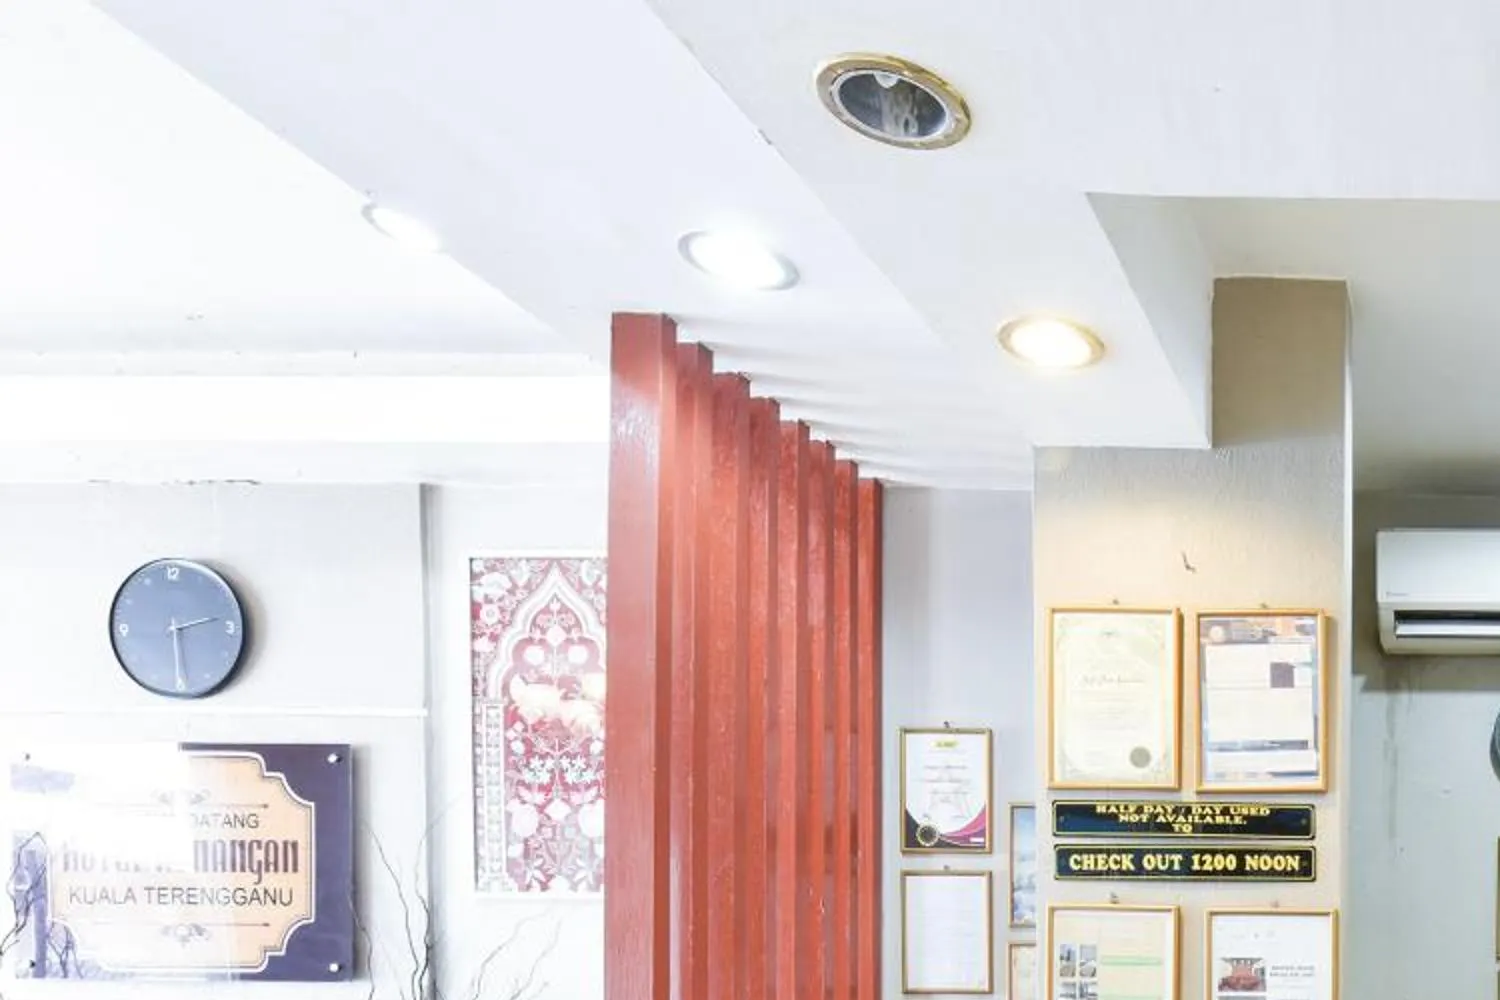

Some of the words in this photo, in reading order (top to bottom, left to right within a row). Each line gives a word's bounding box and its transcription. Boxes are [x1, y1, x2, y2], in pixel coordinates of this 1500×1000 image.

[167, 567, 180, 581] 12
[119, 623, 129, 637] 9
[225, 620, 235, 635] 3
[1096, 804, 1137, 814] HALF
[1143, 804, 1174, 815] DAY
[1191, 805, 1222, 815] DAY
[1229, 805, 1270, 817] USED
[1118, 814, 1150, 823] NOT
[1069, 853, 1136, 871] CHECK
[1142, 853, 1183, 871] OUT
[1191, 854, 1237, 871] 1200
[1245, 854, 1300, 872] NOON
[69, 887, 136, 905] KUALA
[143, 887, 294, 907] TERENGGANU
